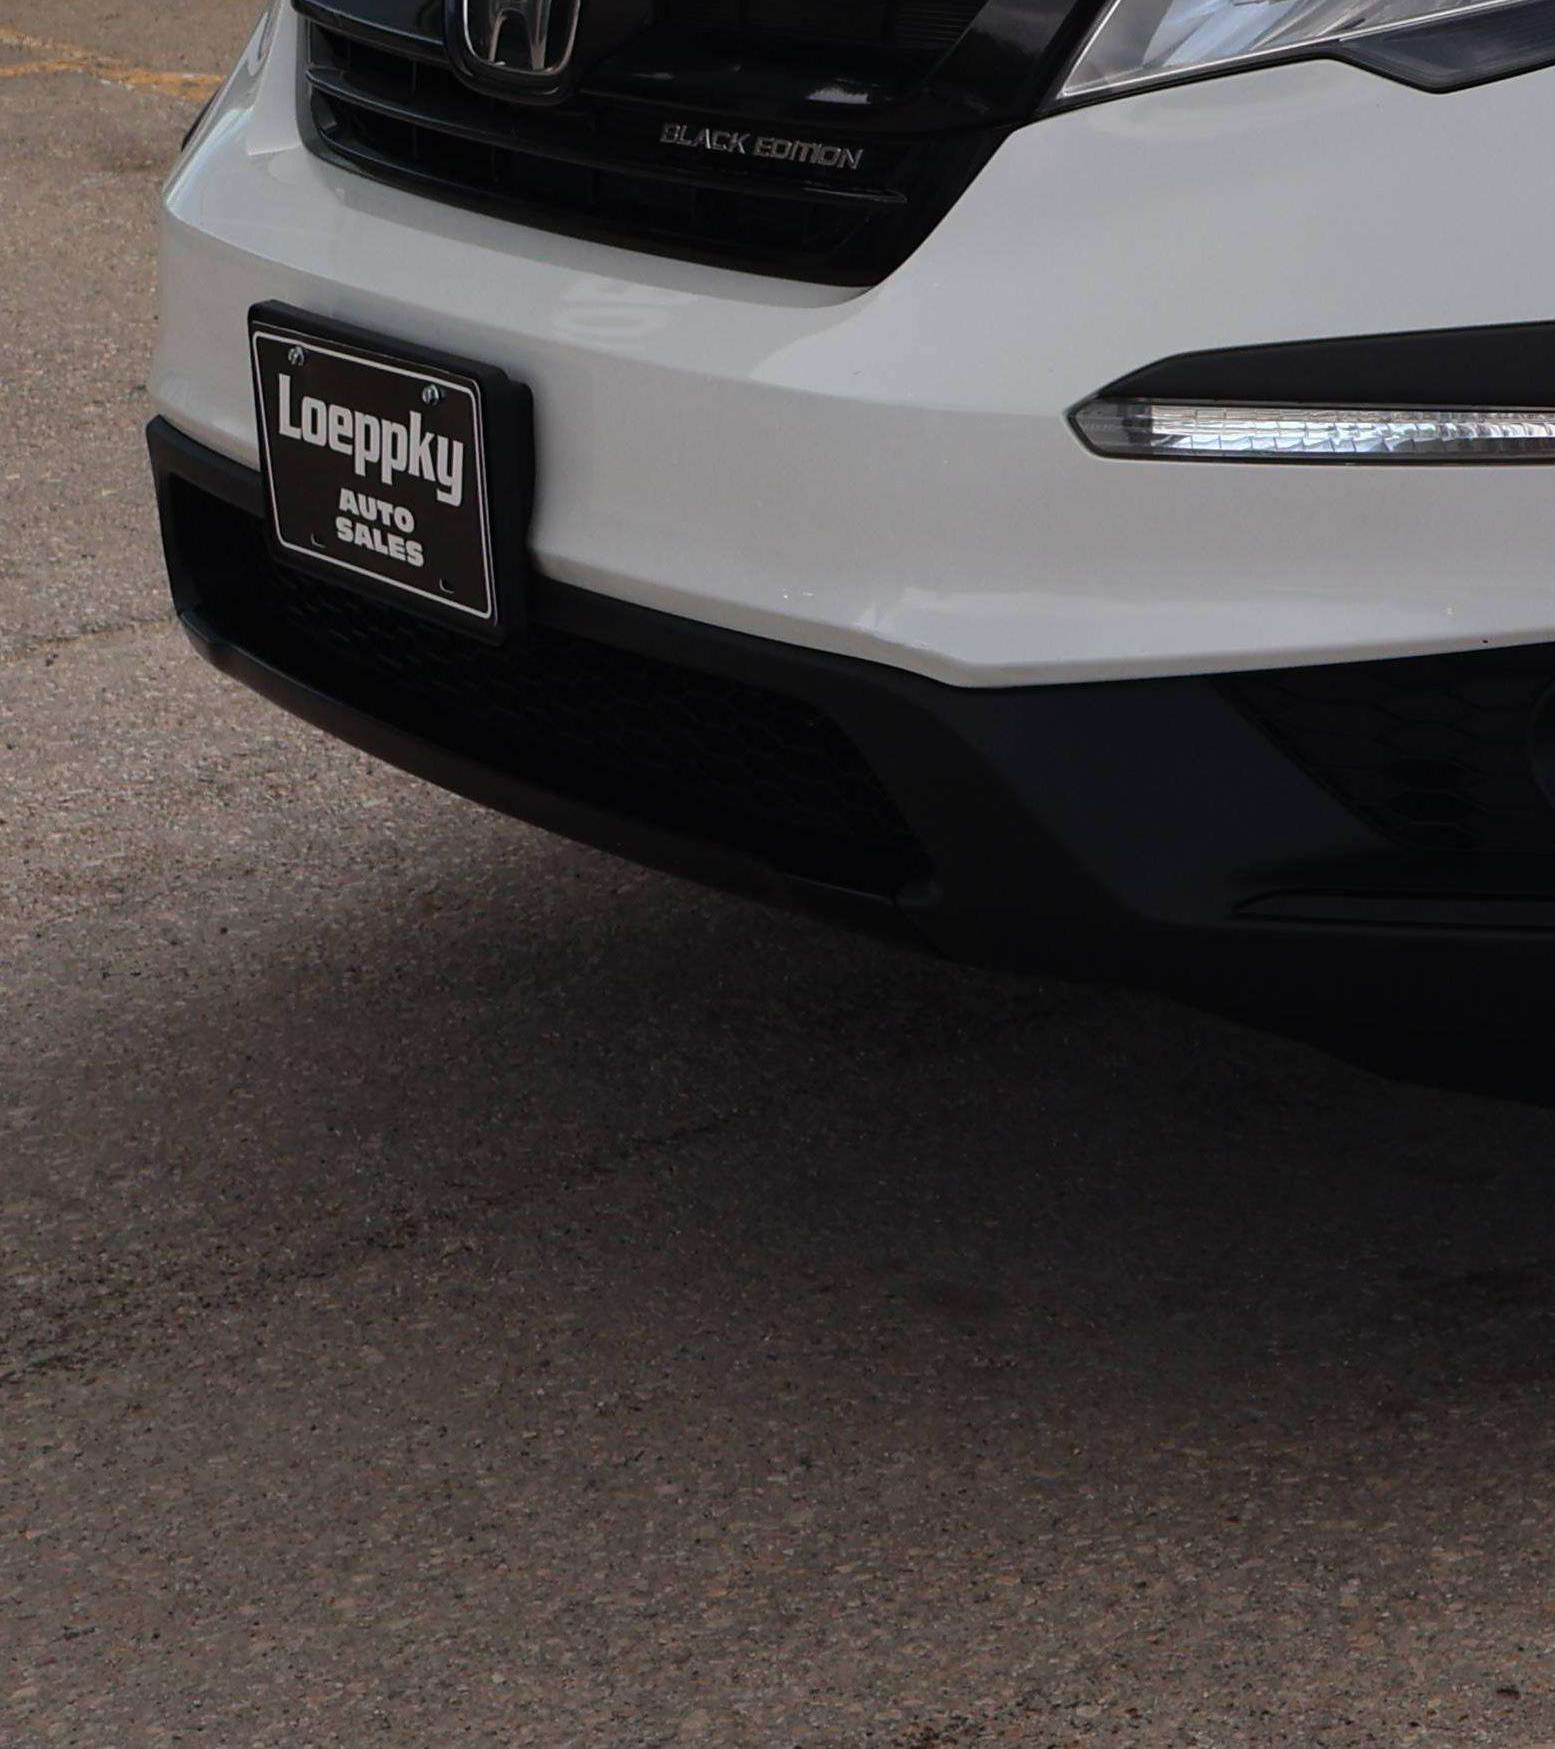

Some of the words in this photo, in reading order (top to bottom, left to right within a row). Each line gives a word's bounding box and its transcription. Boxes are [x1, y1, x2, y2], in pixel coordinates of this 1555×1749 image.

[660, 123, 750, 154] BLACK
[753, 137, 863, 170] EDITION
[278, 373, 464, 507] Loeppky
[339, 488, 415, 534] AUTO
[336, 516, 425, 567] SALES
